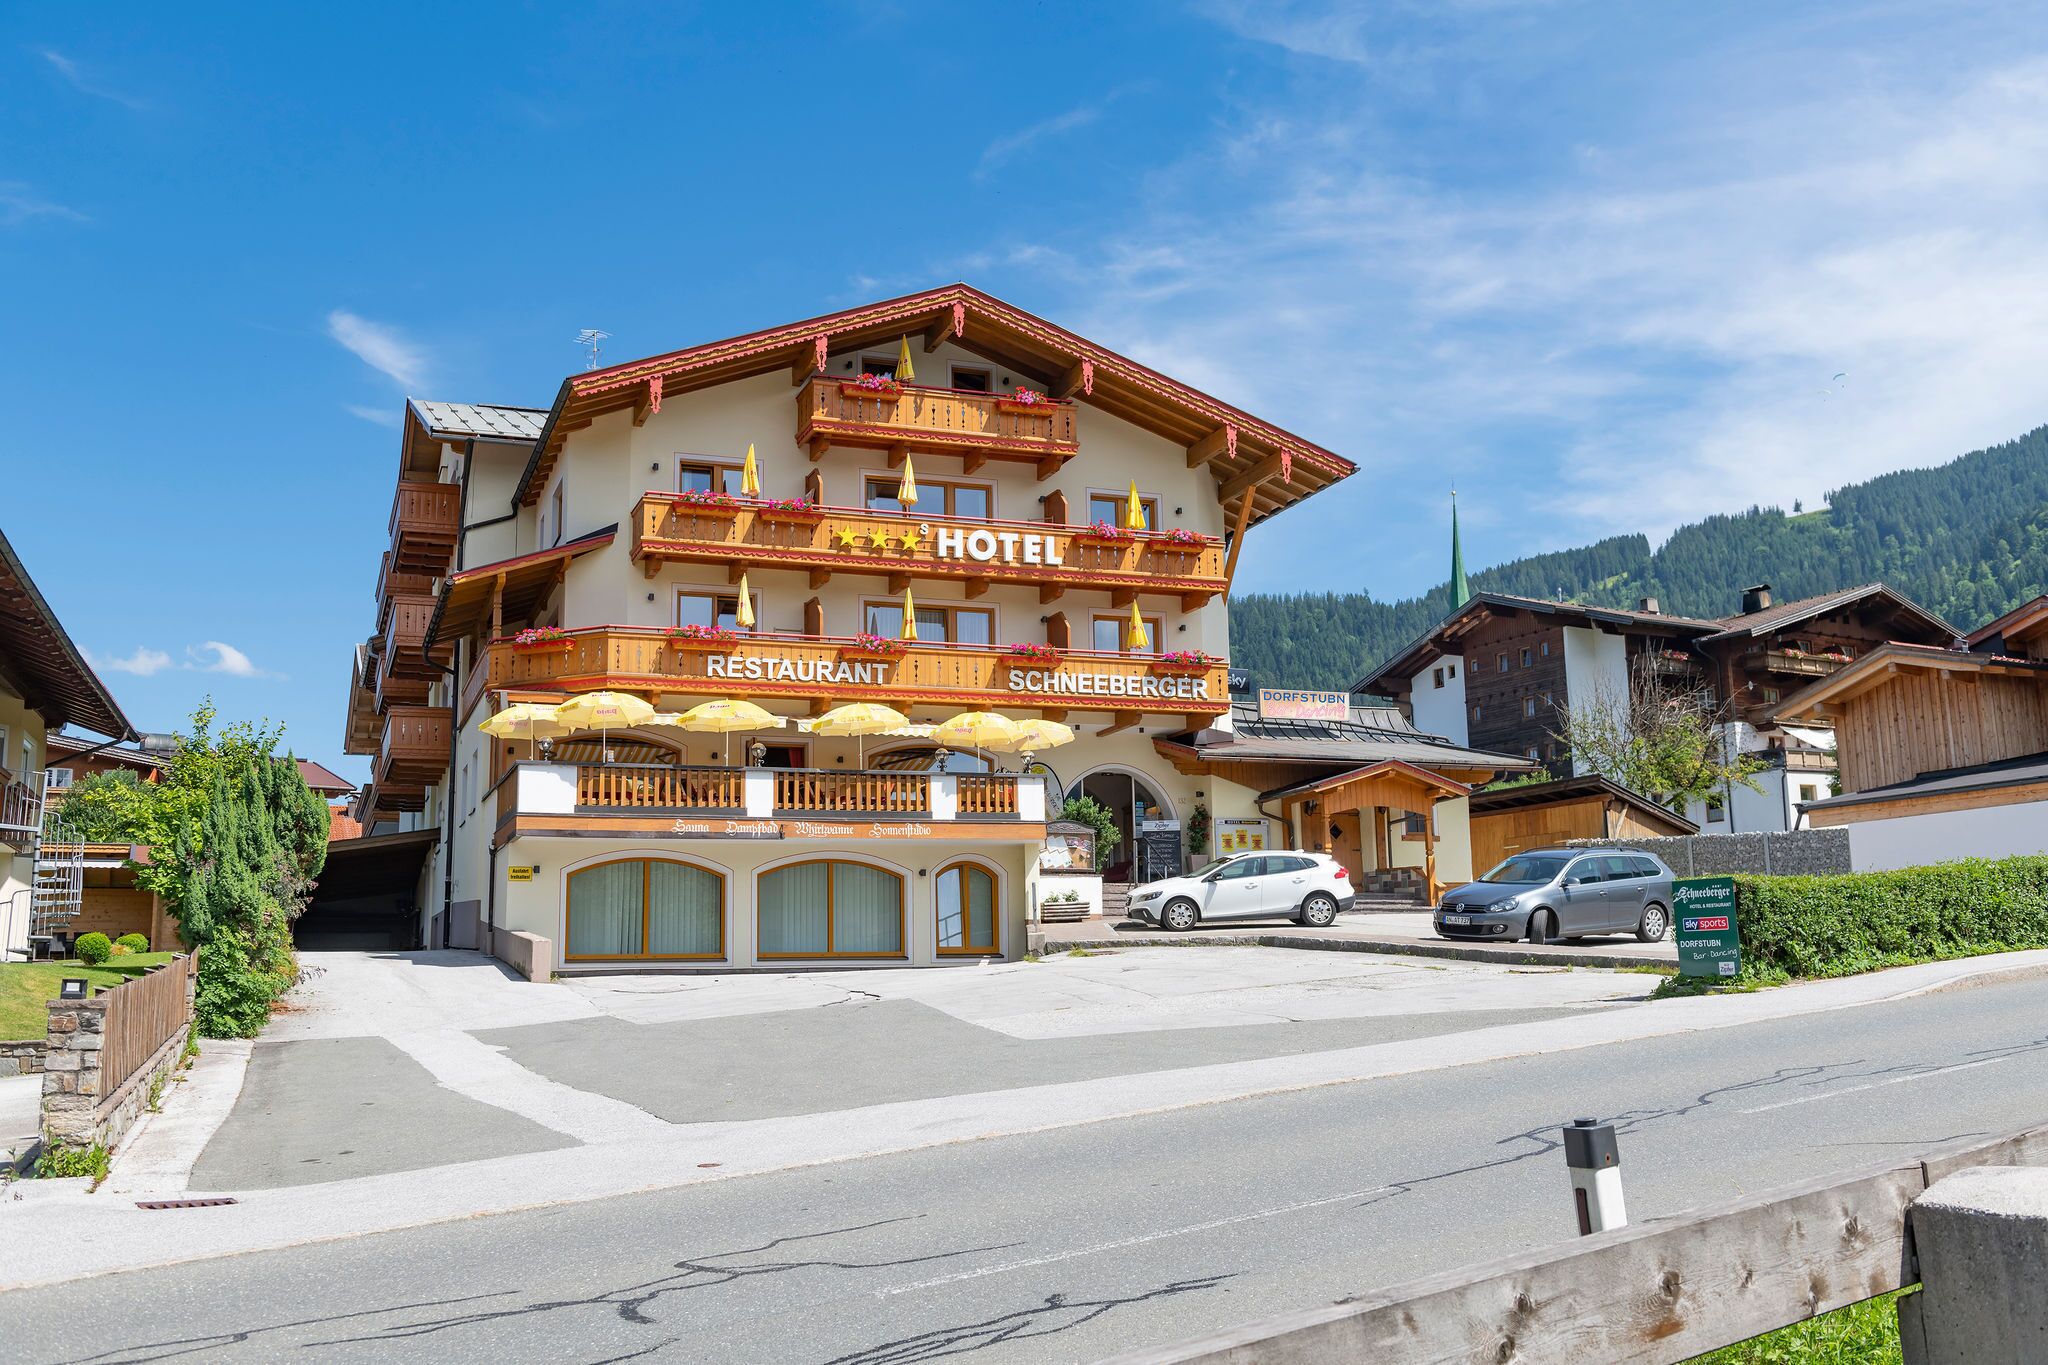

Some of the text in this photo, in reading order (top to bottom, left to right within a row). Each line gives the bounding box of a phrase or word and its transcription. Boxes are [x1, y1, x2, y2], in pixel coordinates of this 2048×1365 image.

[937, 527, 1063, 565] HOTEL
[706, 655, 889, 684] RESTAURANT
[1008, 669, 1209, 699] SCHNEEBERGER
[1263, 691, 1345, 704] DORFSTUBN
[671, 818, 932, 838] Sauna Dampfbad Whirlwanne Sonnenstudio
[1673, 887, 1730, 903] Schneeberger
[1685, 919, 1727, 929] sky sports
[1680, 939, 1721, 948] DORFSTUBN
[1710, 948, 1738, 959] Dancing
